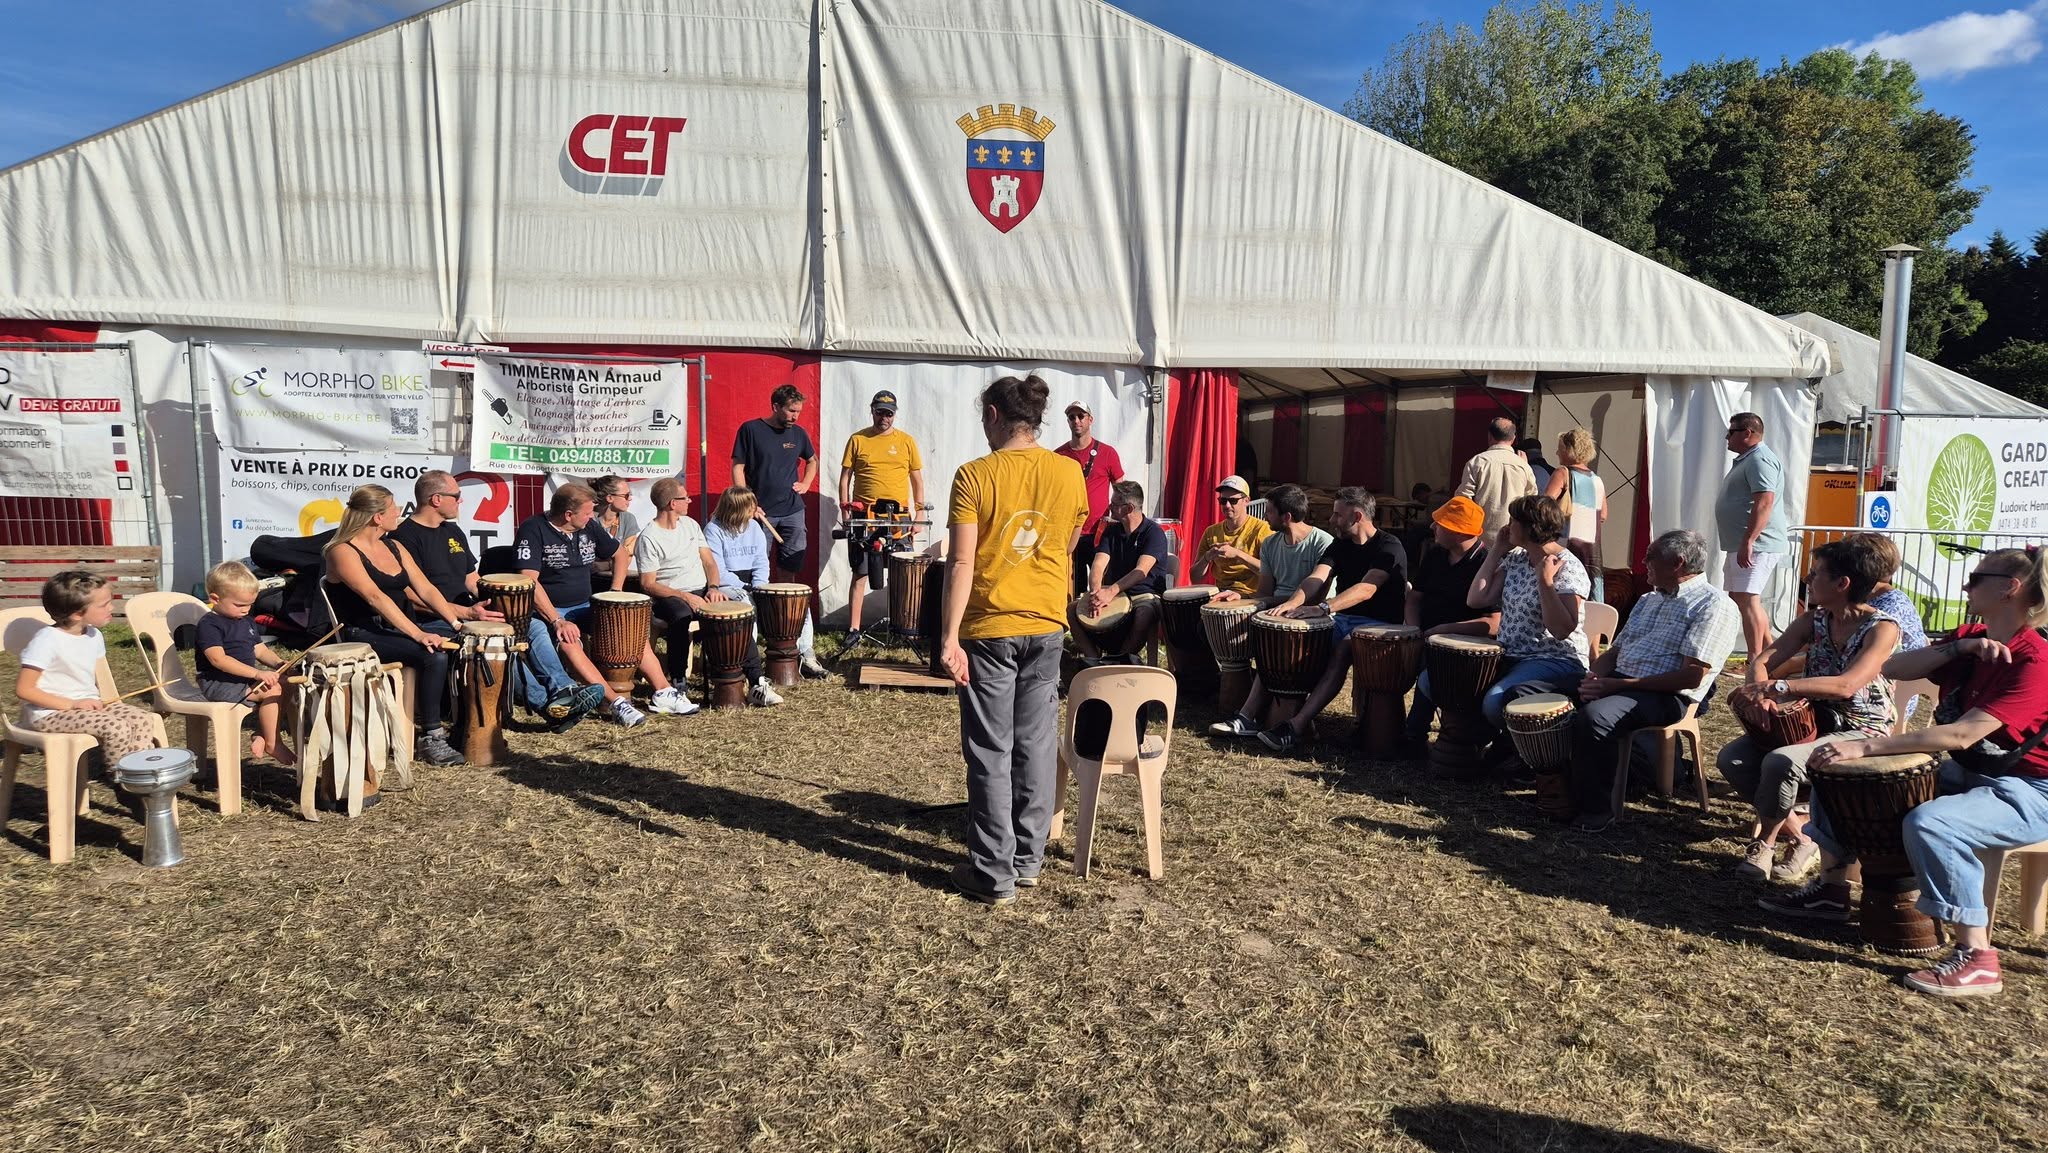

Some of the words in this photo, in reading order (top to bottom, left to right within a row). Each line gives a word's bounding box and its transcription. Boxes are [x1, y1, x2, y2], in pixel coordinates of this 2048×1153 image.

[567, 114, 688, 176] CET
[499, 362, 599, 382] TIMMERMAN
[605, 369, 661, 383] Arnaud
[284, 371, 375, 390] MORPHO
[382, 374, 424, 391] BIKE
[516, 379, 574, 394] Arboriste
[579, 383, 643, 397] Grimpeur
[22, 399, 59, 411] DEVIS
[63, 399, 119, 411] GRATUIT
[559, 397, 601, 408] Abattage
[603, 397, 646, 407] d'arbres
[534, 407, 573, 420] Rognage
[575, 411, 588, 420] de
[589, 411, 628, 420] souches
[519, 419, 590, 433] Aménagements
[593, 424, 642, 433] extérieurs
[491, 431, 515, 442] Pose
[517, 433, 529, 442] de
[573, 436, 602, 446] Petits
[604, 437, 670, 446] terrassements
[506, 445, 544, 462] TEL:
[549, 448, 655, 464] 0494/888.707
[2001, 442, 2048, 463] GARD
[230, 458, 287, 475] VENTE
[292, 457, 304, 475] À
[308, 462, 348, 477] PRIX
[353, 464, 376, 478] DE
[525, 463, 559, 473] Déportés
[231, 477, 278, 490] boissons,
[280, 480, 310, 492] chips,
[2000, 500, 2028, 513] Ludovic
[470, 529, 498, 557] T
[517, 548, 531, 560] 18
